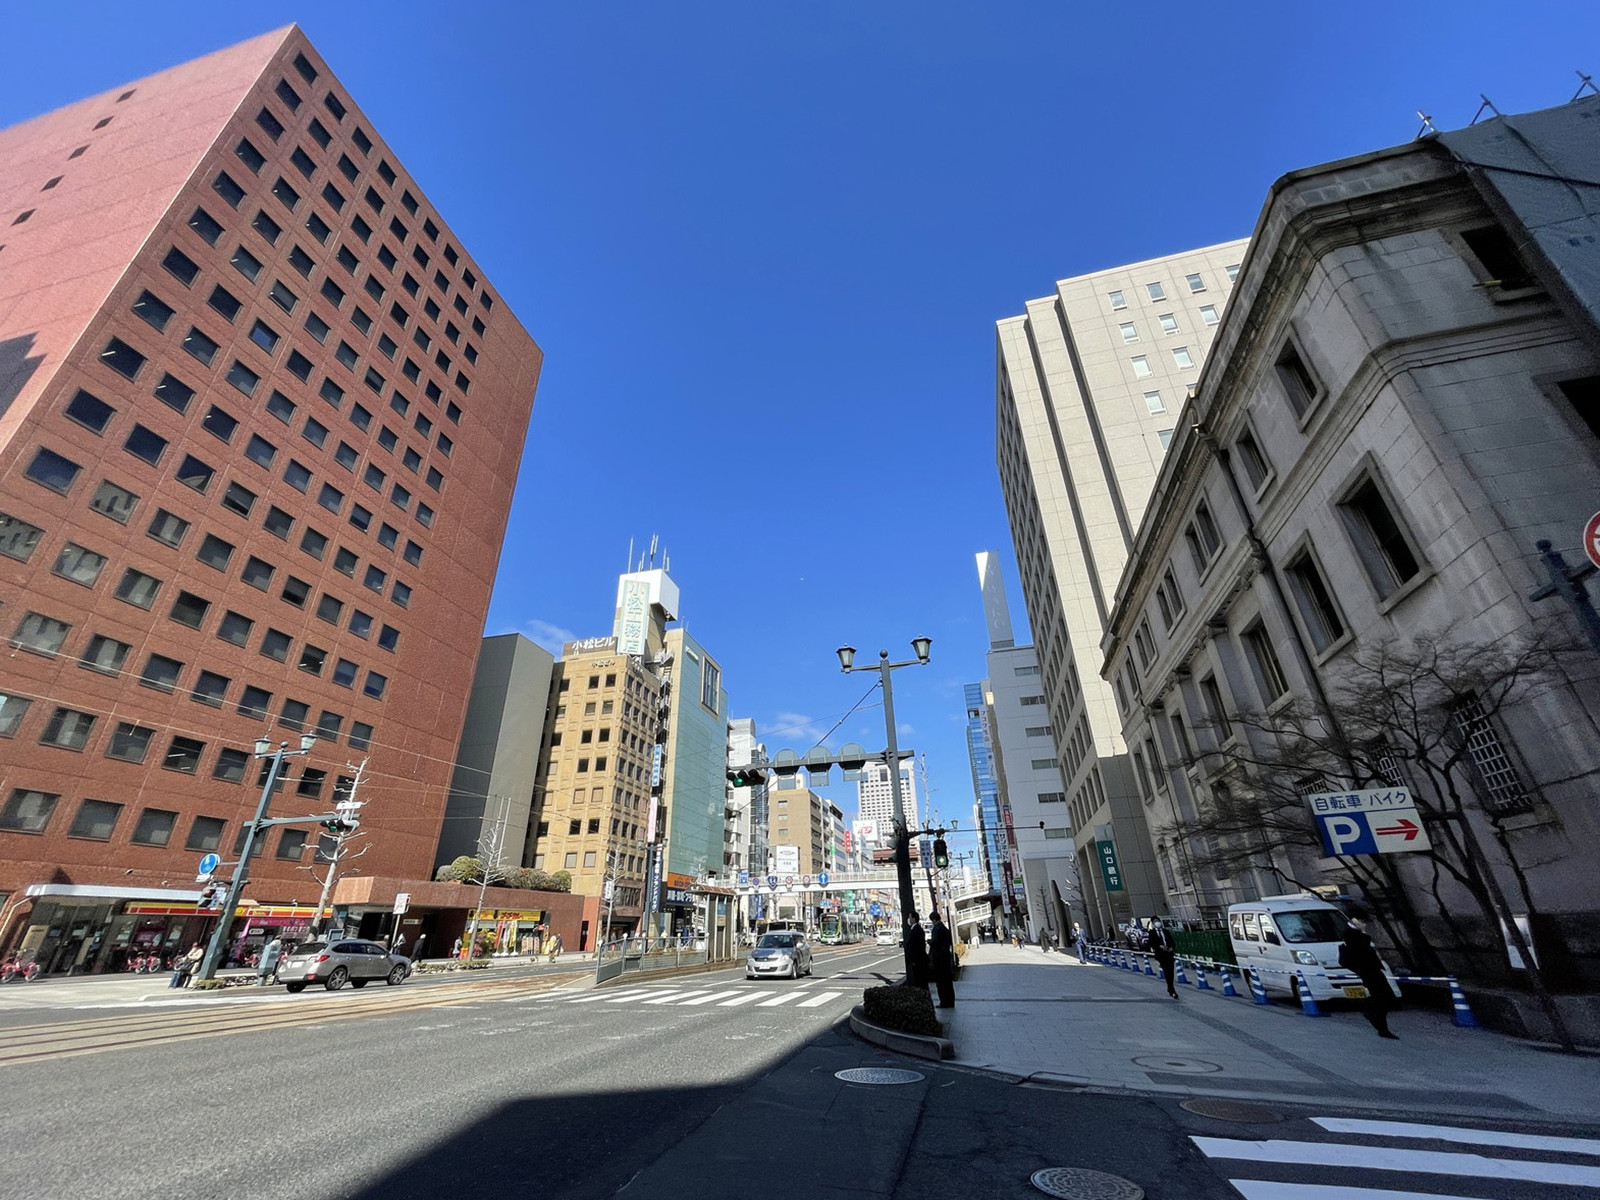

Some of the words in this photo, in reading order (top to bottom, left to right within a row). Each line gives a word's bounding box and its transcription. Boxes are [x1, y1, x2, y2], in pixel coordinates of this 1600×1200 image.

[624, 584, 644, 653] 小松工務店
[572, 637, 615, 651] 小松ビル
[1323, 816, 1361, 854] P
[1103, 846, 1118, 886] 山口銀行
